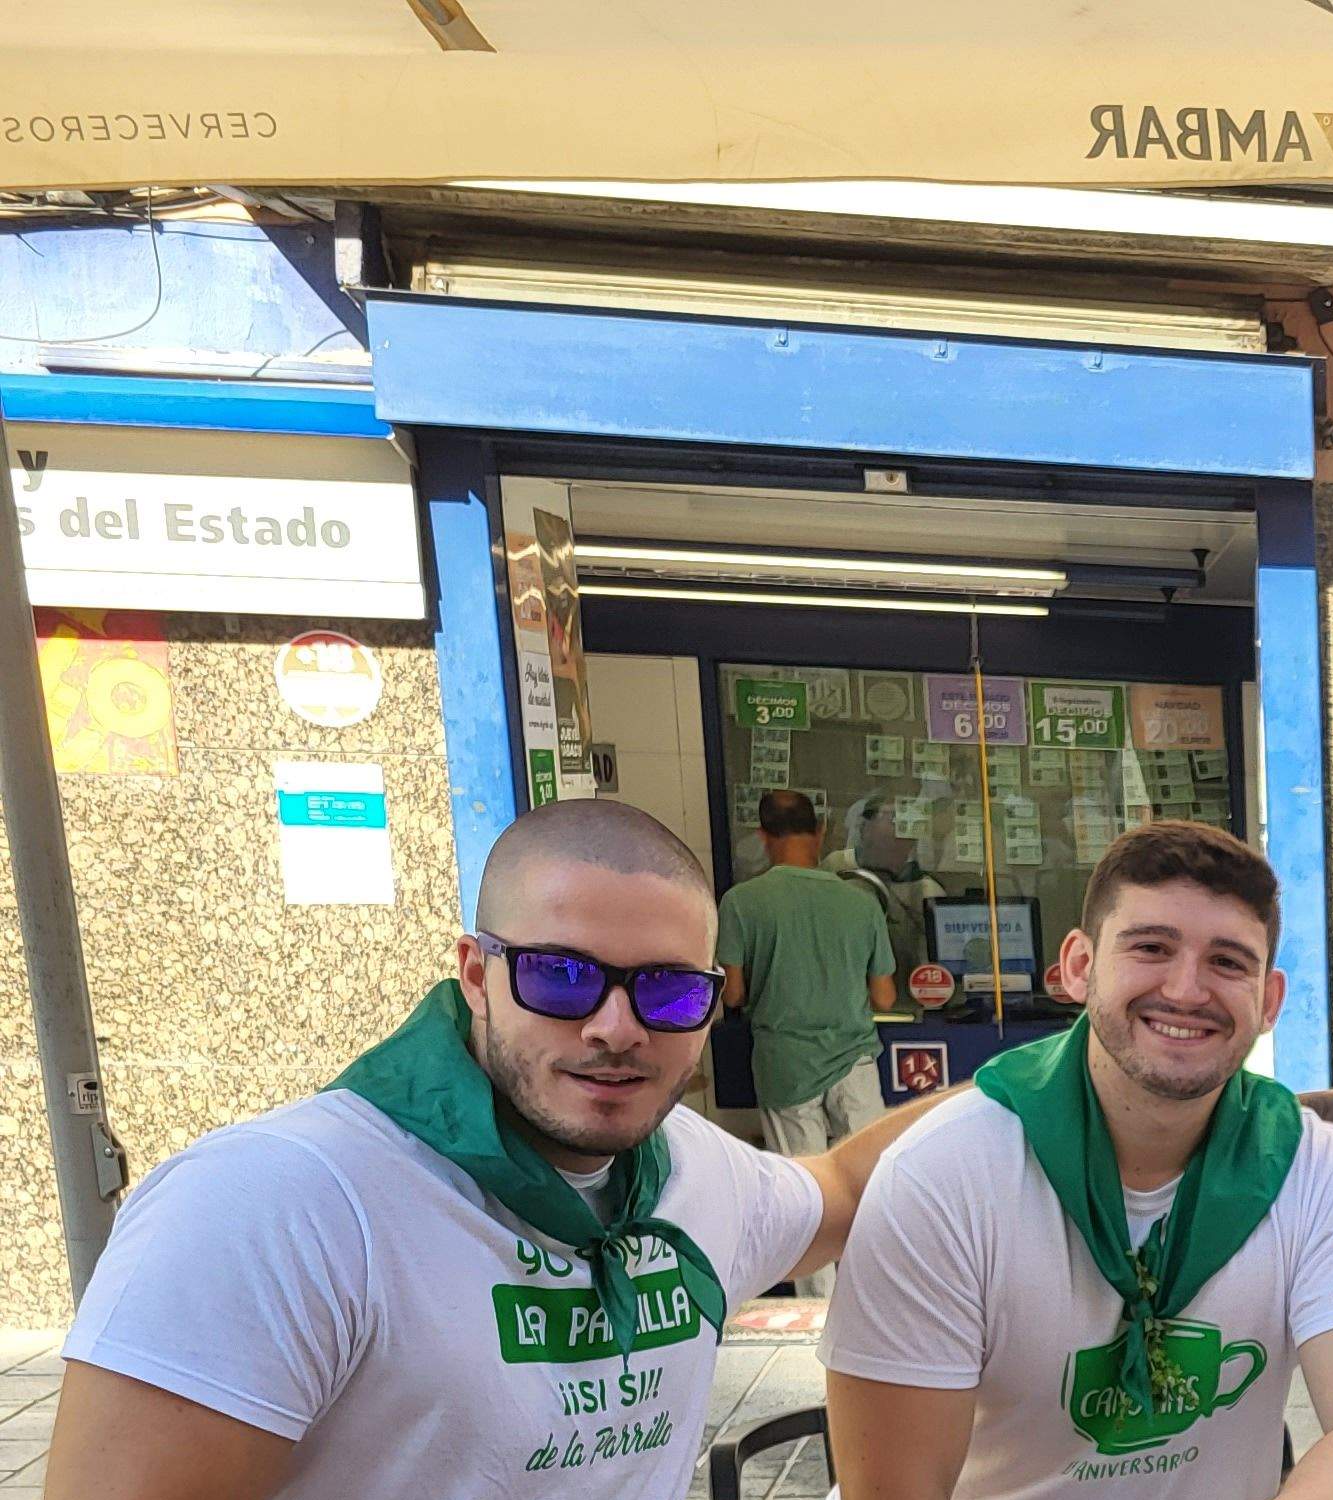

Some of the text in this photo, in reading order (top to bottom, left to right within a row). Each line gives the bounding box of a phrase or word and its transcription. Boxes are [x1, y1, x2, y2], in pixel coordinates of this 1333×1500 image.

[17, 450, 48, 492] y
[59, 497, 140, 540] del
[164, 503, 351, 548] Estado
[1036, 717, 1108, 743] 15,00
[515, 1286, 691, 1347] LA PAILLA
[525, 1410, 674, 1472] de la Parrilla
[1073, 1446, 1199, 1482] ANIVERSARIO
